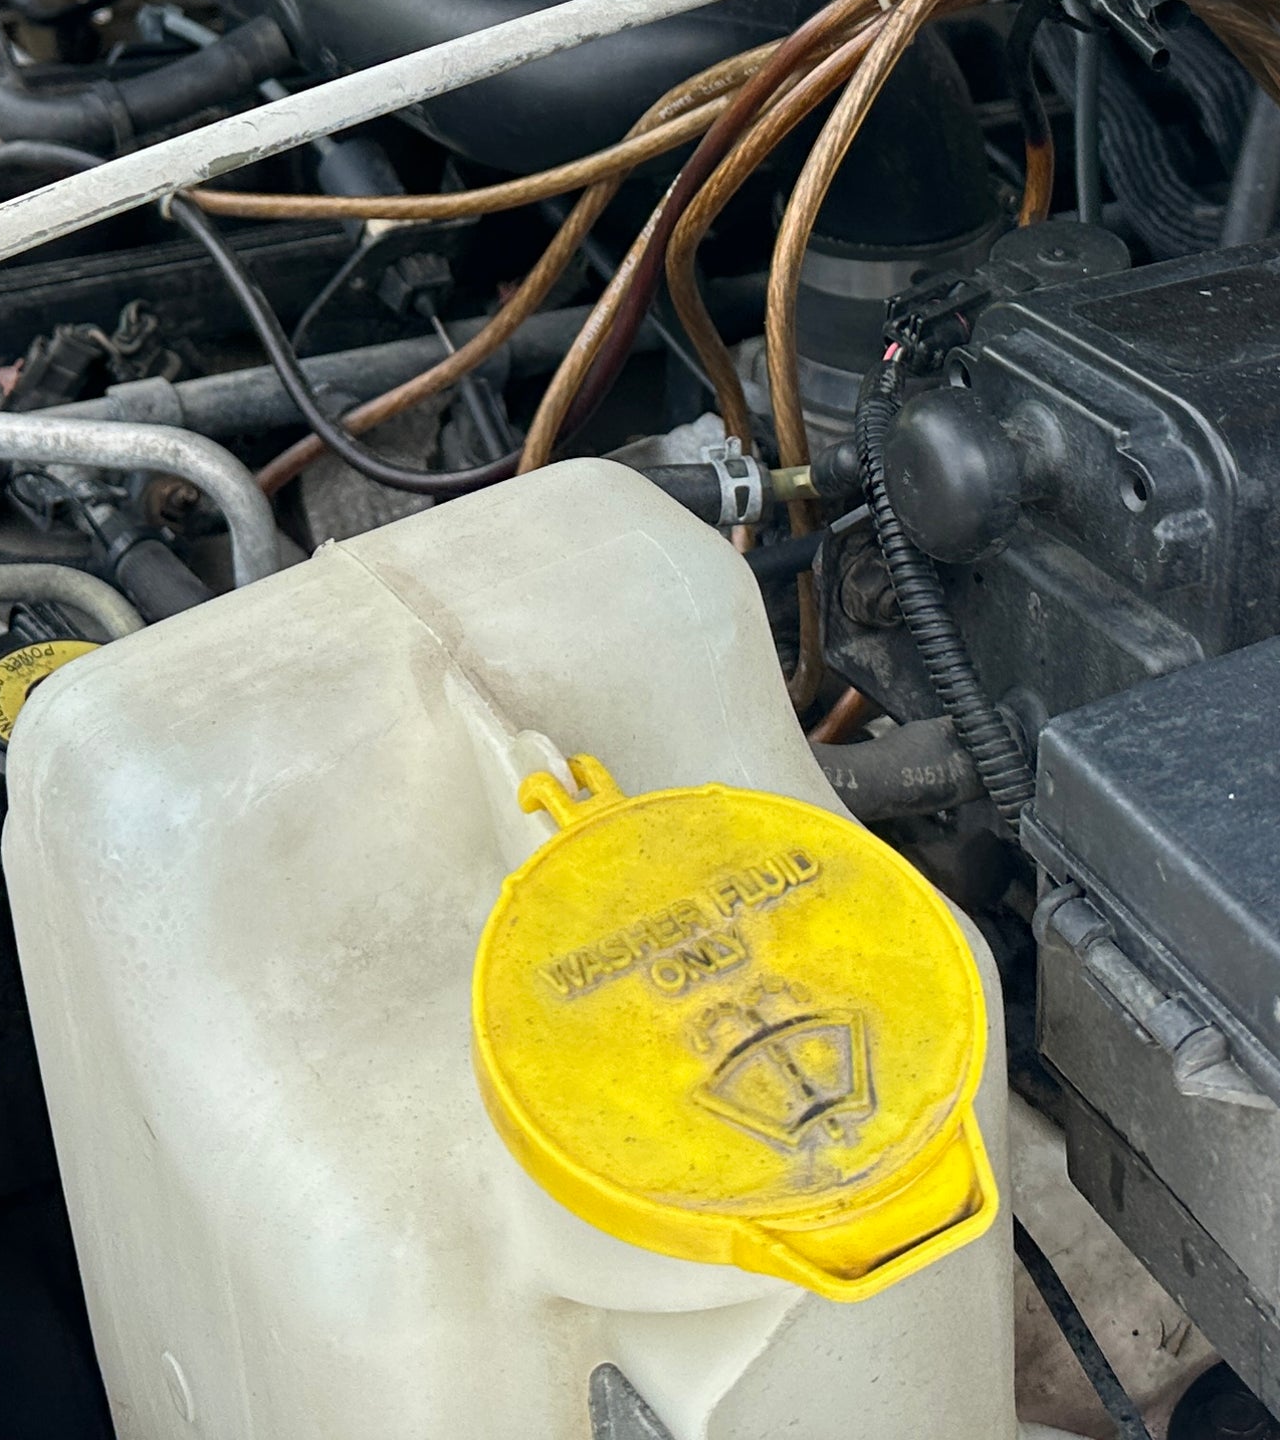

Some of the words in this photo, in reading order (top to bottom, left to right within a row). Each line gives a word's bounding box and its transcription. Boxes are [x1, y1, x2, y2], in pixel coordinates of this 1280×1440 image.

[0, 644, 55, 673] POWER
[536, 898, 712, 999] WASHER
[707, 847, 822, 920] FLUID
[650, 927, 750, 997] ONLY
